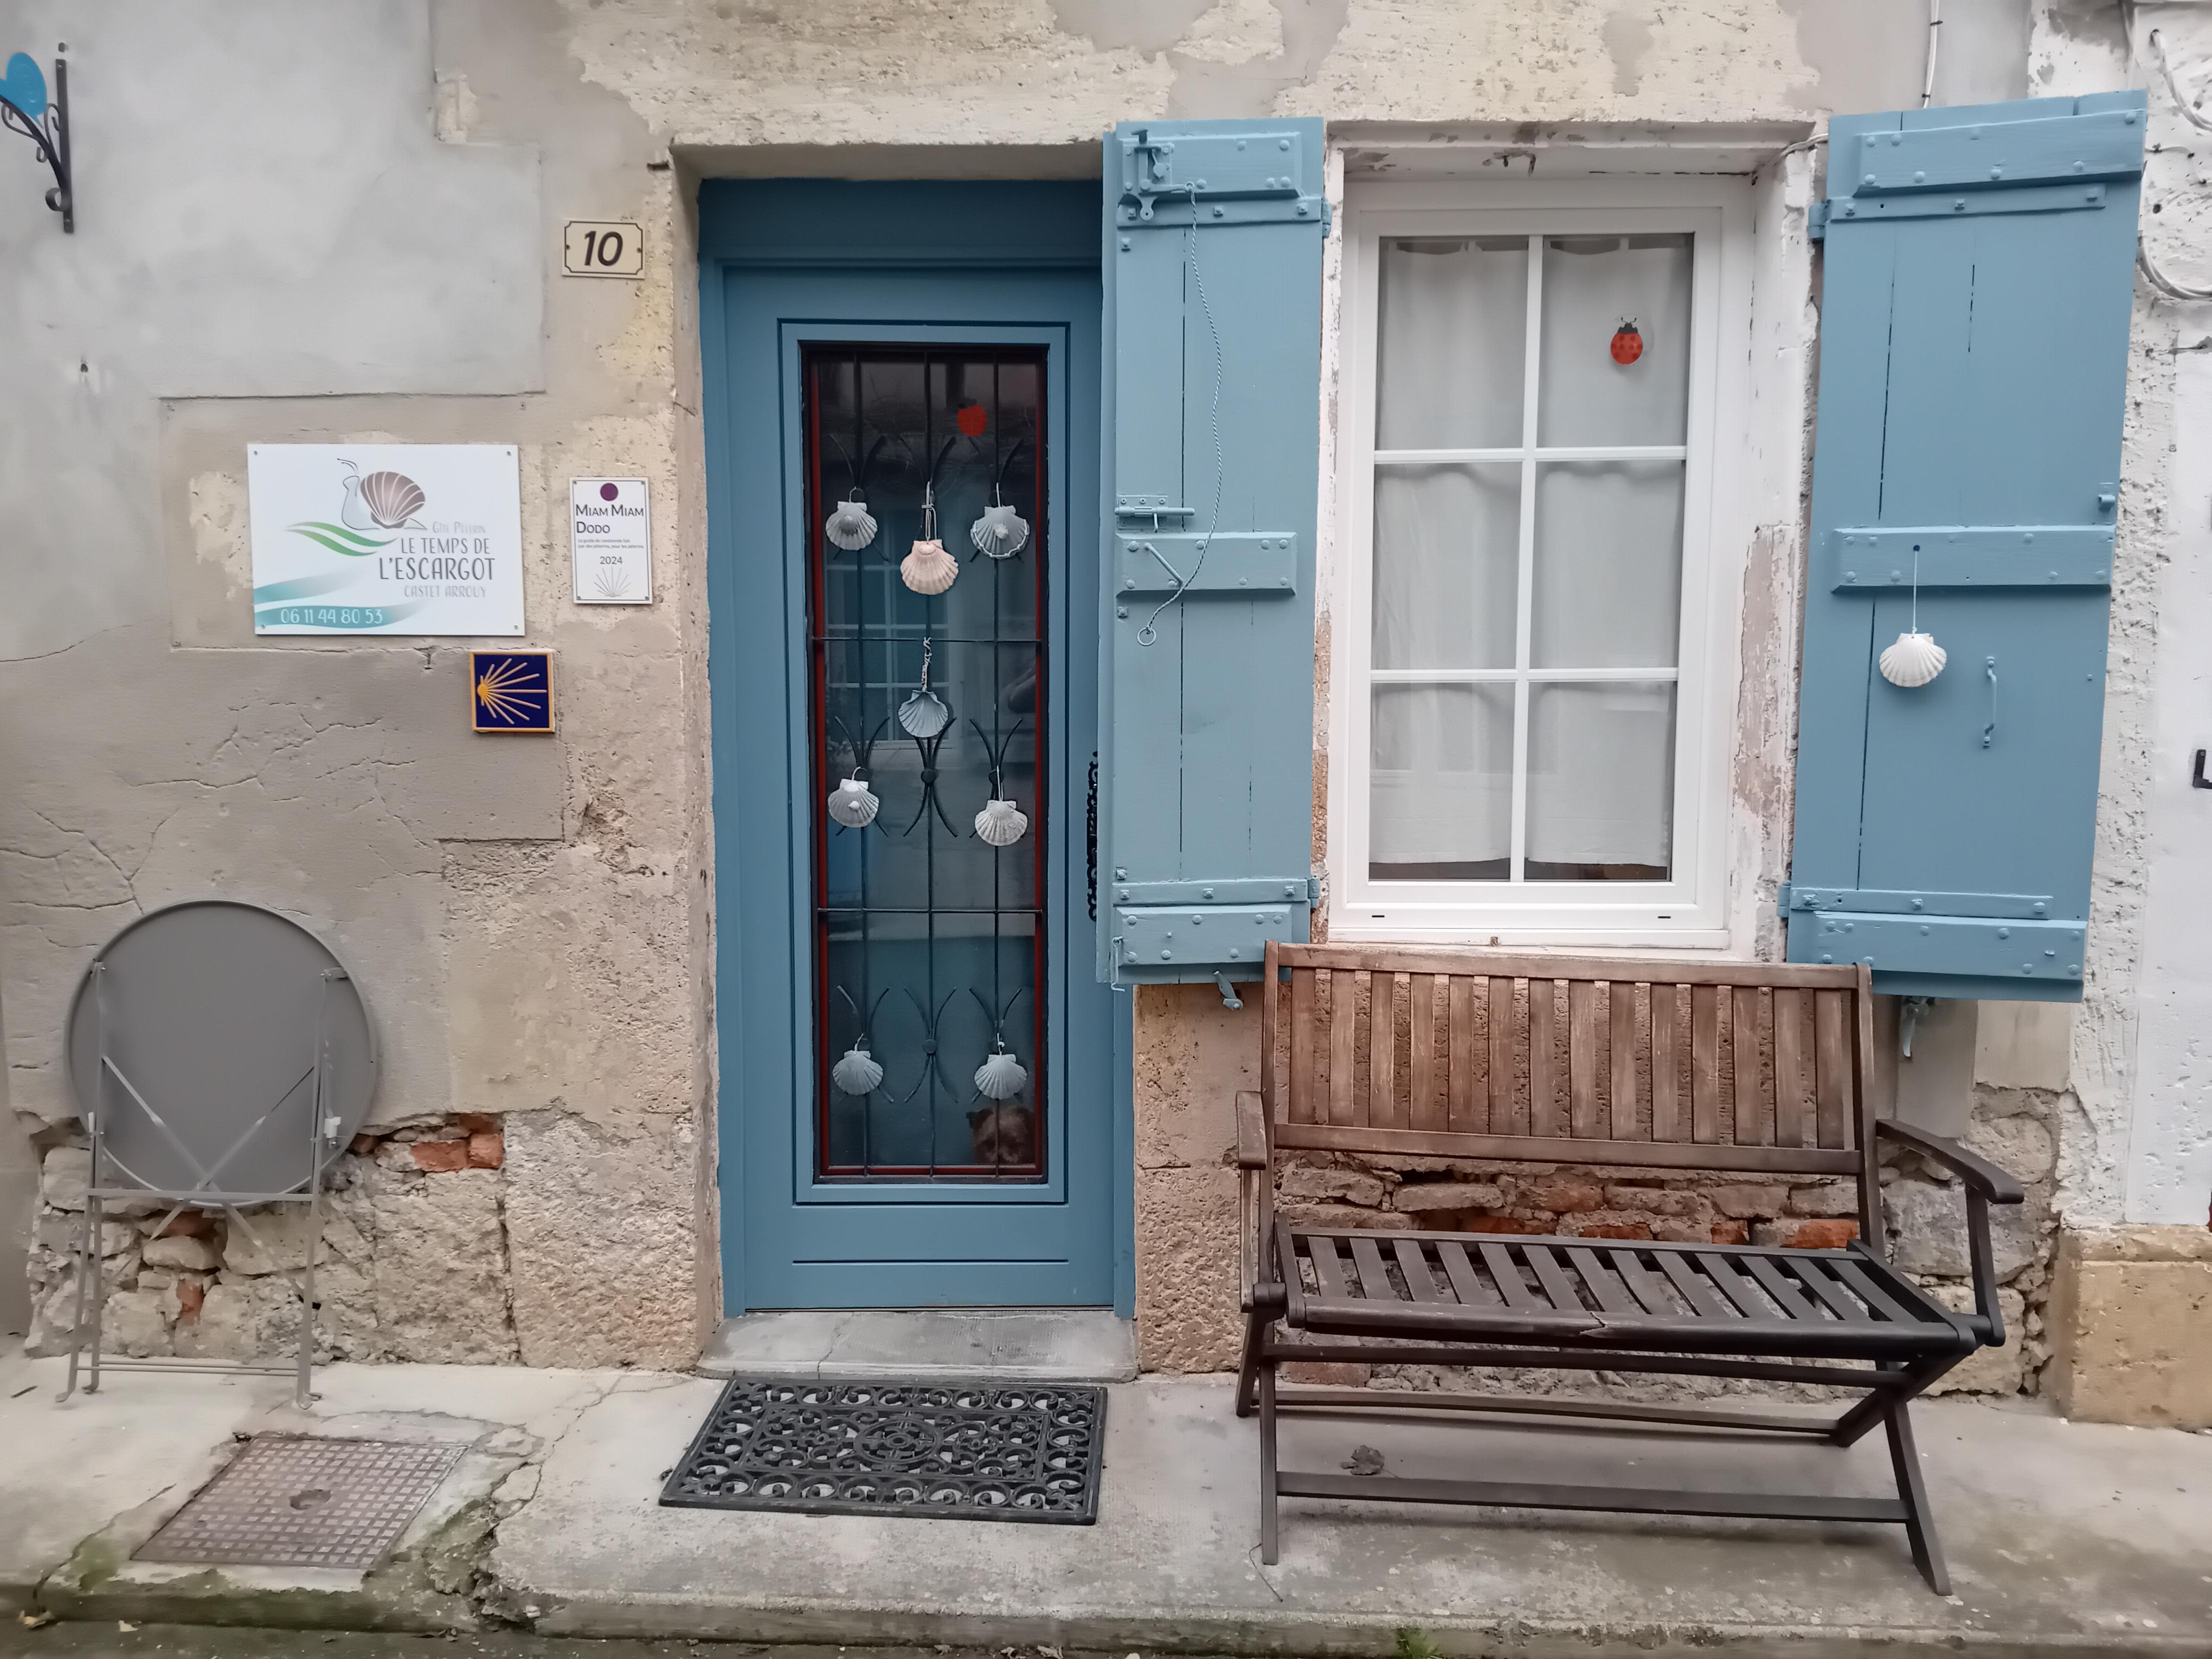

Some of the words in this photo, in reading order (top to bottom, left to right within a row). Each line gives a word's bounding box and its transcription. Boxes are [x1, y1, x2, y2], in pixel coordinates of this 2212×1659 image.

[584, 230, 623, 267] 10
[575, 504, 608, 516] MIAM
[611, 504, 644, 516] MIAM
[576, 521, 610, 533] DODO
[401, 538, 416, 554] LE
[420, 538, 468, 554] TEMPS
[474, 538, 490, 554] DE
[600, 556, 622, 564] 2024
[379, 557, 496, 580] L'ESCARGOT
[404, 585, 441, 597] CASTET
[445, 585, 486, 597] ARROUY
[280, 608, 299, 623] 06
[304, 609, 313, 623] 11
[318, 609, 336, 623] 44
[341, 608, 360, 623] 80
[365, 608, 383, 623] 53
